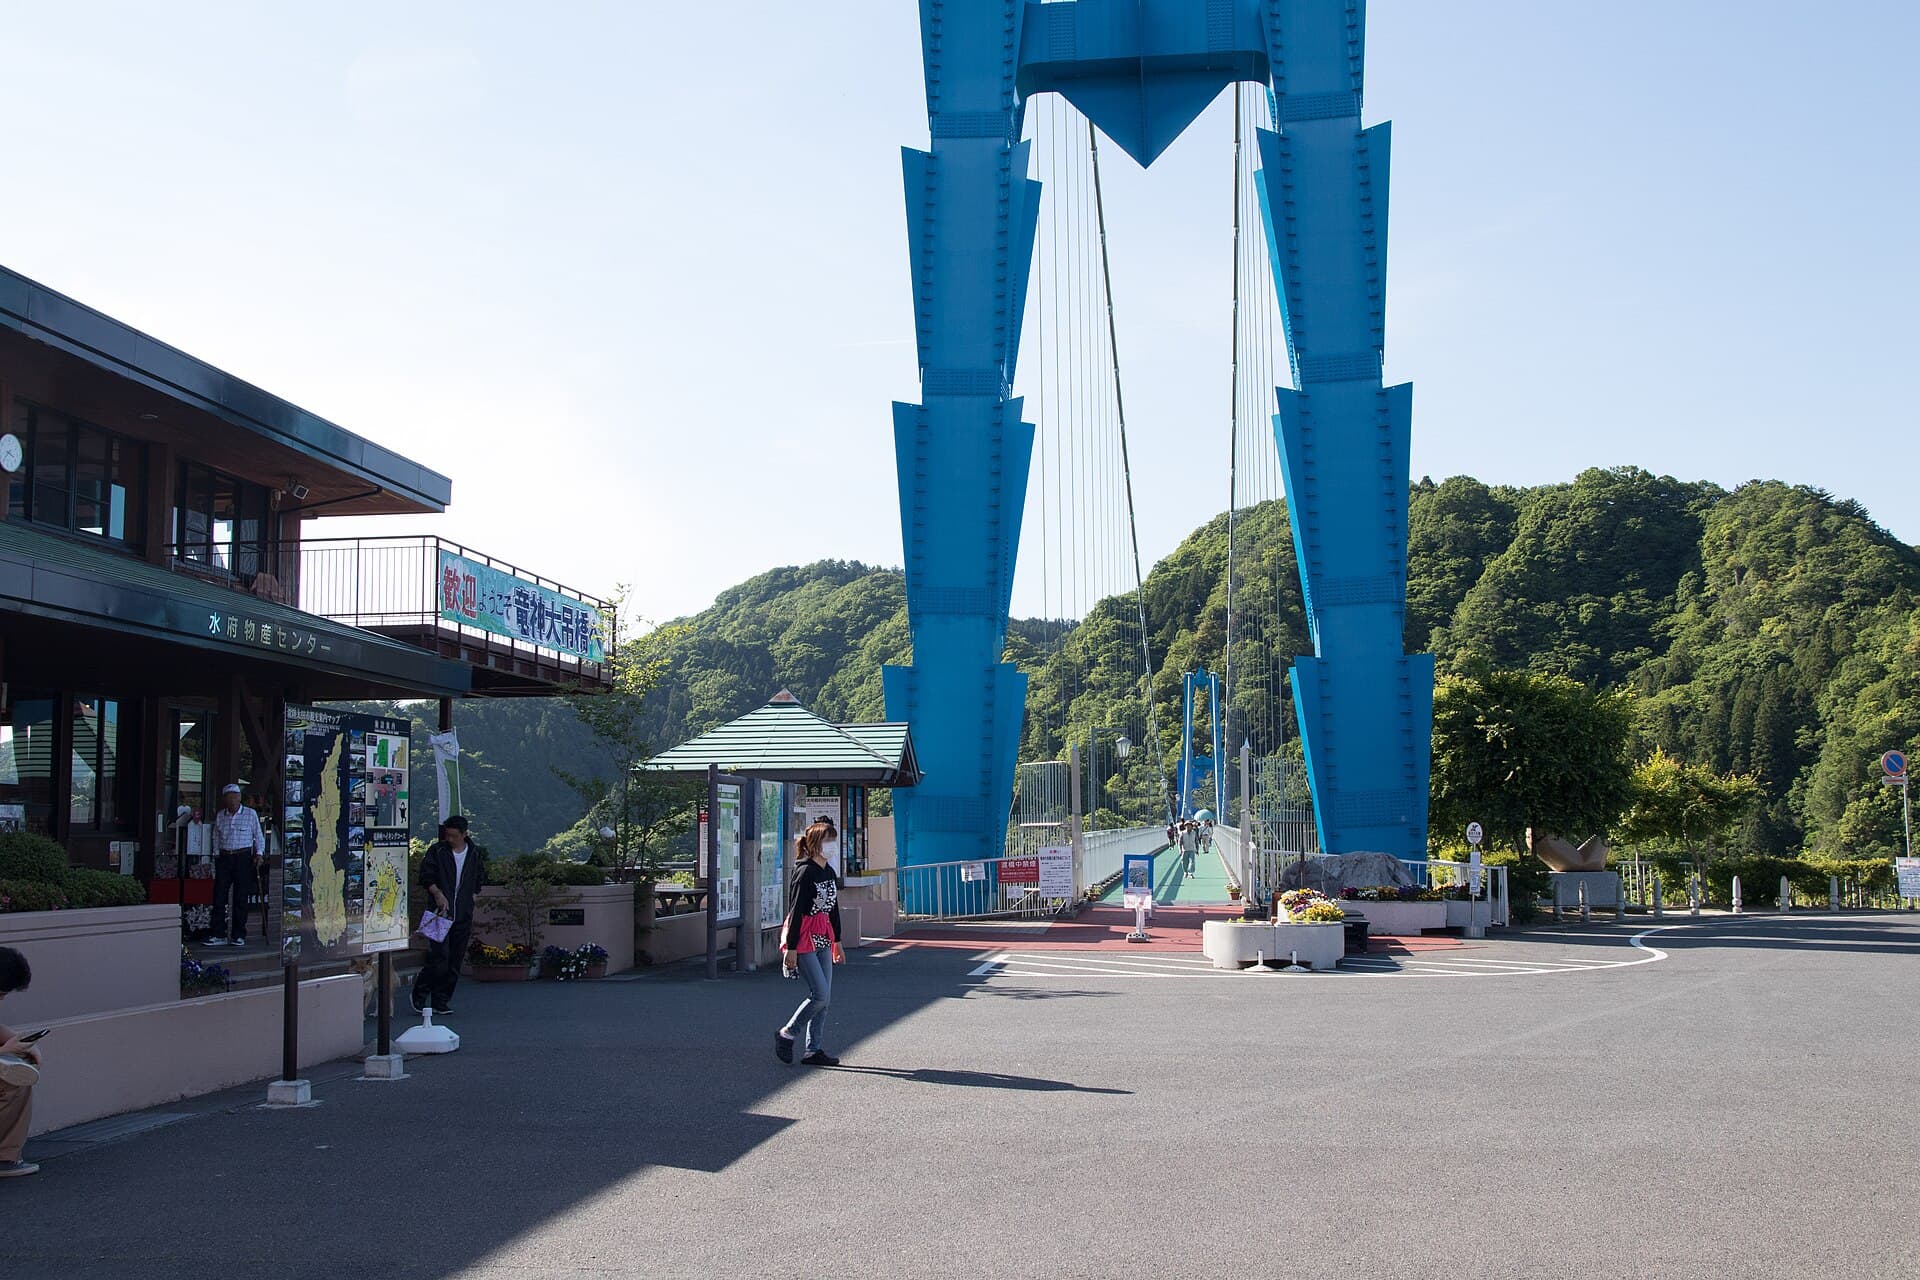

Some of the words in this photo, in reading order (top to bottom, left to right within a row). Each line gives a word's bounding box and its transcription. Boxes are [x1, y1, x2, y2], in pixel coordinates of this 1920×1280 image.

[443, 565, 477, 619] 歓迎
[479, 586, 512, 619] ようこそ
[208, 612, 331, 654] 水府物産センター
